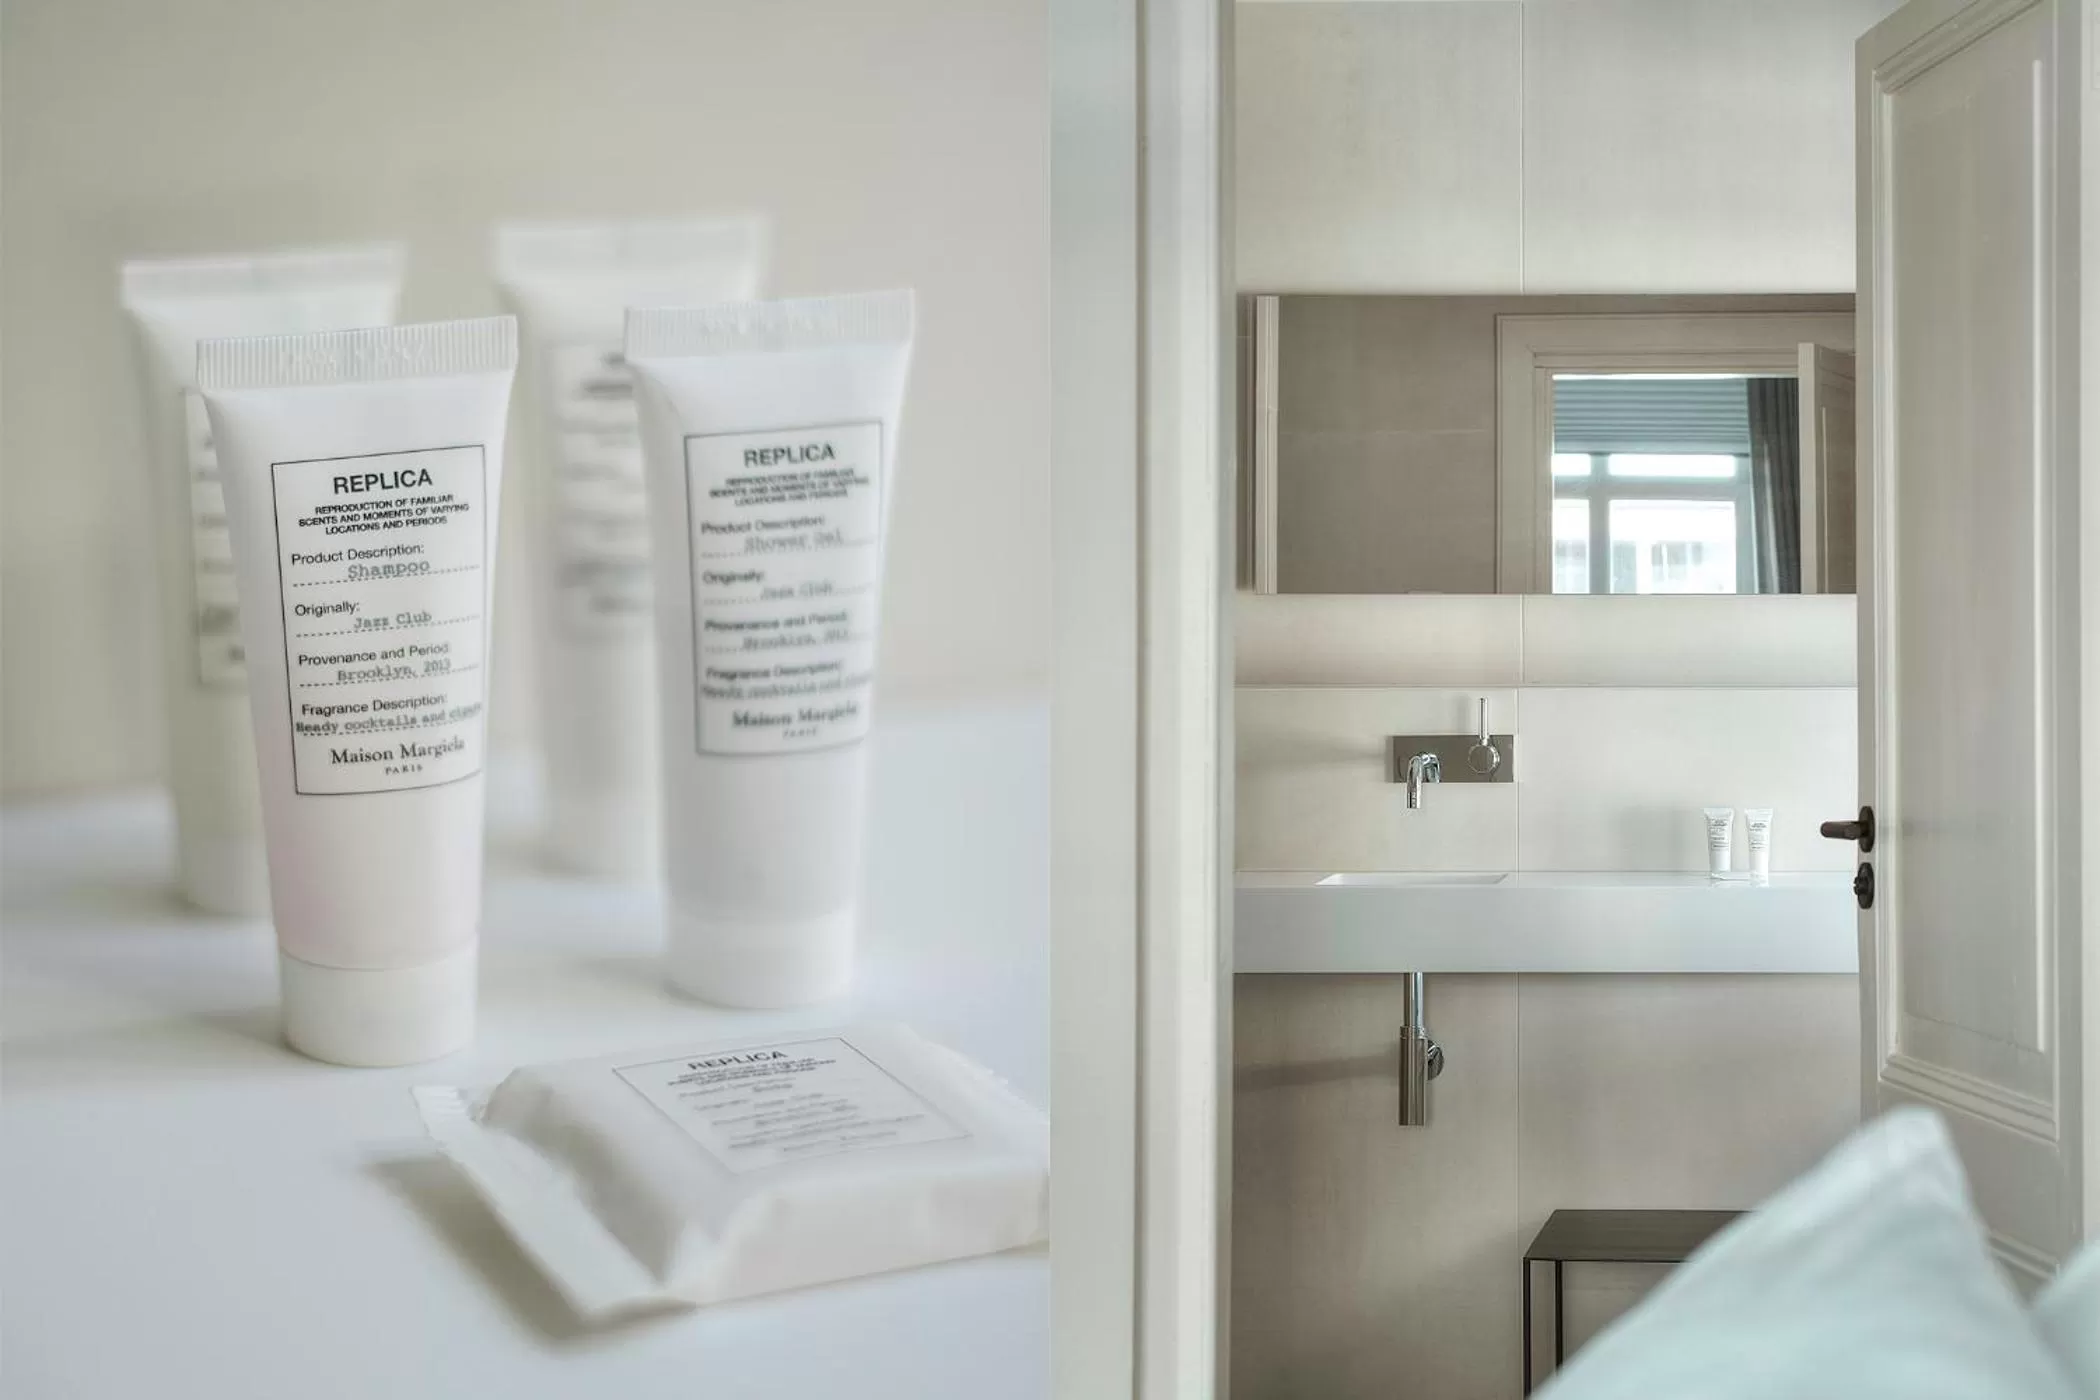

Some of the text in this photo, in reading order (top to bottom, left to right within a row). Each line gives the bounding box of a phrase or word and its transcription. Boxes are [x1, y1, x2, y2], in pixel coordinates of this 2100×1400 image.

[743, 442, 835, 468] REPLICA
[333, 468, 432, 494] REPLICA
[315, 494, 454, 514] REPRODUCTION OF FAMILIAR
[299, 503, 470, 527] SCENTS AND MOMENTS OF VARYING
[326, 515, 448, 534] LOCATIONS AND PERIODS
[291, 544, 424, 565] Product Description:
[348, 560, 430, 579] Shampoo
[294, 601, 360, 618] Originally:
[353, 611, 432, 630] Jazz Club
[298, 652, 376, 666] Provenance
[381, 647, 405, 660] and
[302, 694, 448, 716] Fragrance Description:
[344, 713, 417, 730] cocktails
[422, 709, 446, 724] and
[331, 735, 464, 764] Maison Margiela
[385, 764, 423, 776] PARIS
[688, 1050, 788, 1070] REPLICA
